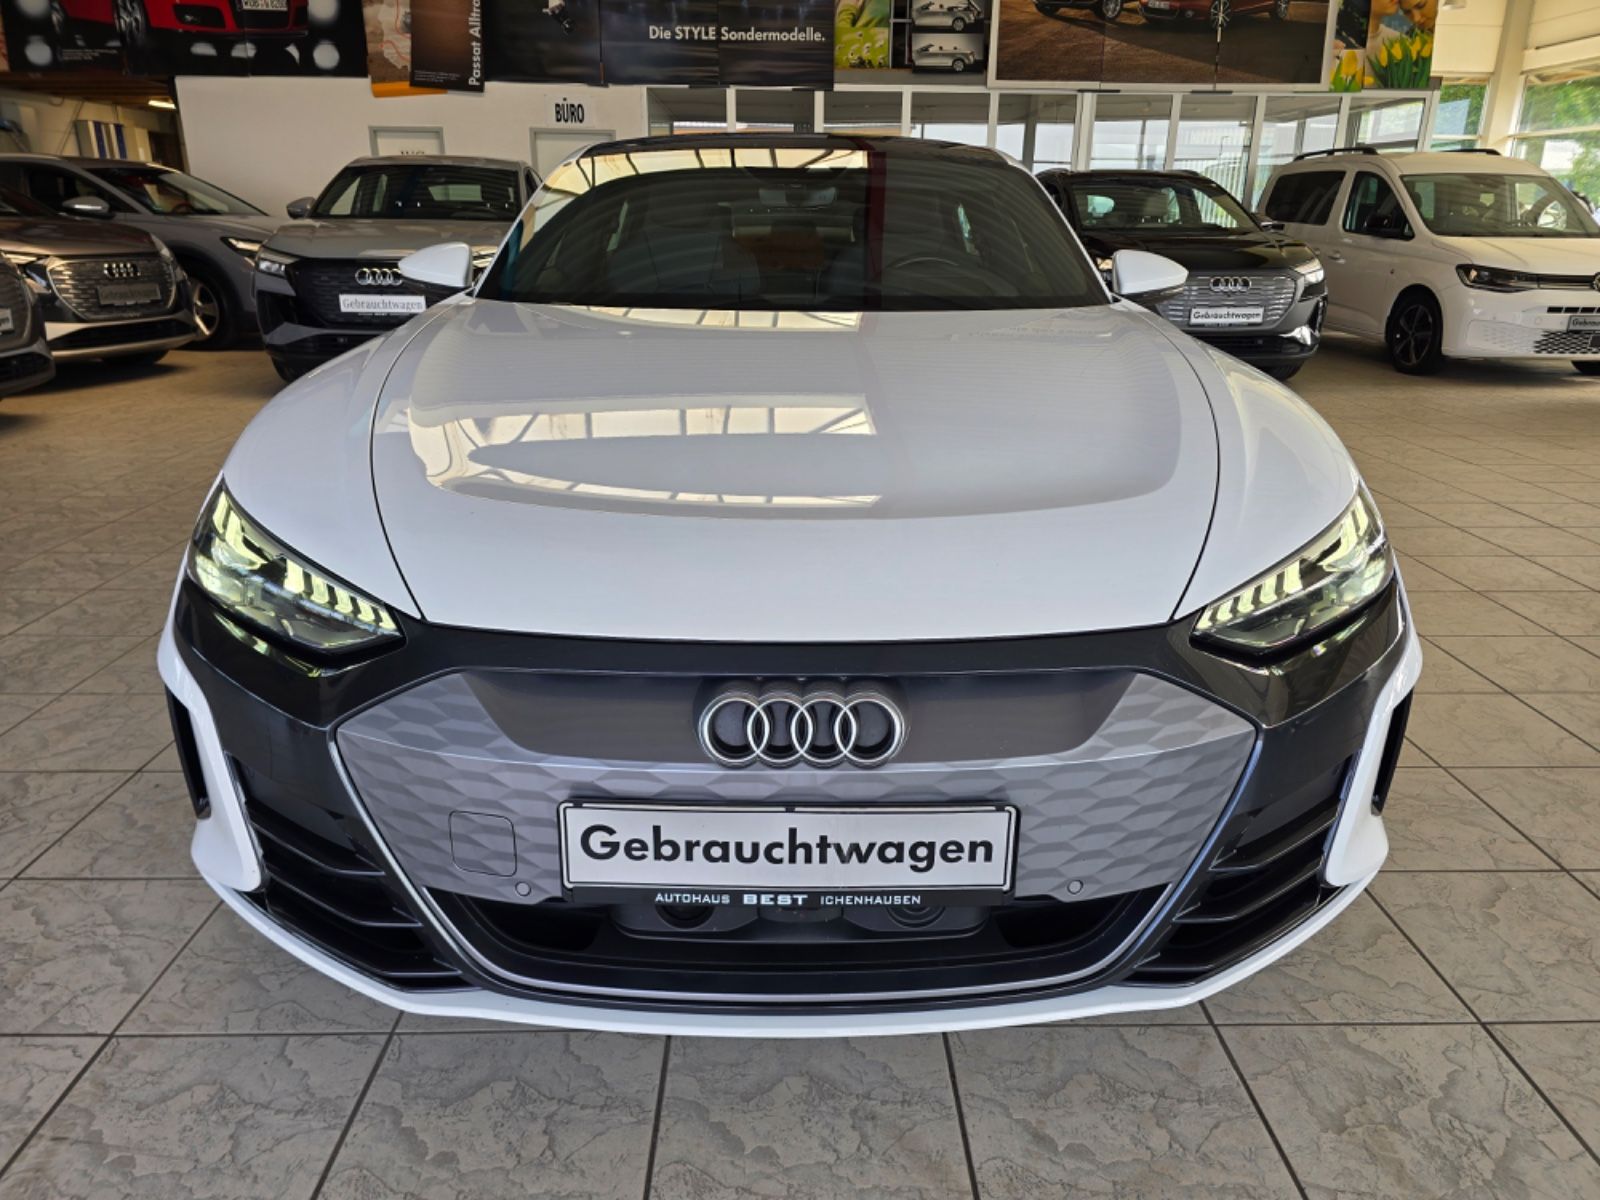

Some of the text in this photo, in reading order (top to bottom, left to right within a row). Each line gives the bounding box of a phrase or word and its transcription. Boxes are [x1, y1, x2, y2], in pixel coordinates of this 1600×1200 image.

[649, 25, 826, 42] Die STYLE Sondermodelle.
[468, 42, 481, 87] Passat
[554, 97, 585, 124] BÜRO
[341, 298, 424, 312] Gebrauchtwagen
[1193, 310, 1261, 321] Gebrauchtwagen
[580, 823, 993, 873] Gebrauchtwagen
[655, 892, 921, 906] AUTOHAUS BEST ICHENHAUSEN
